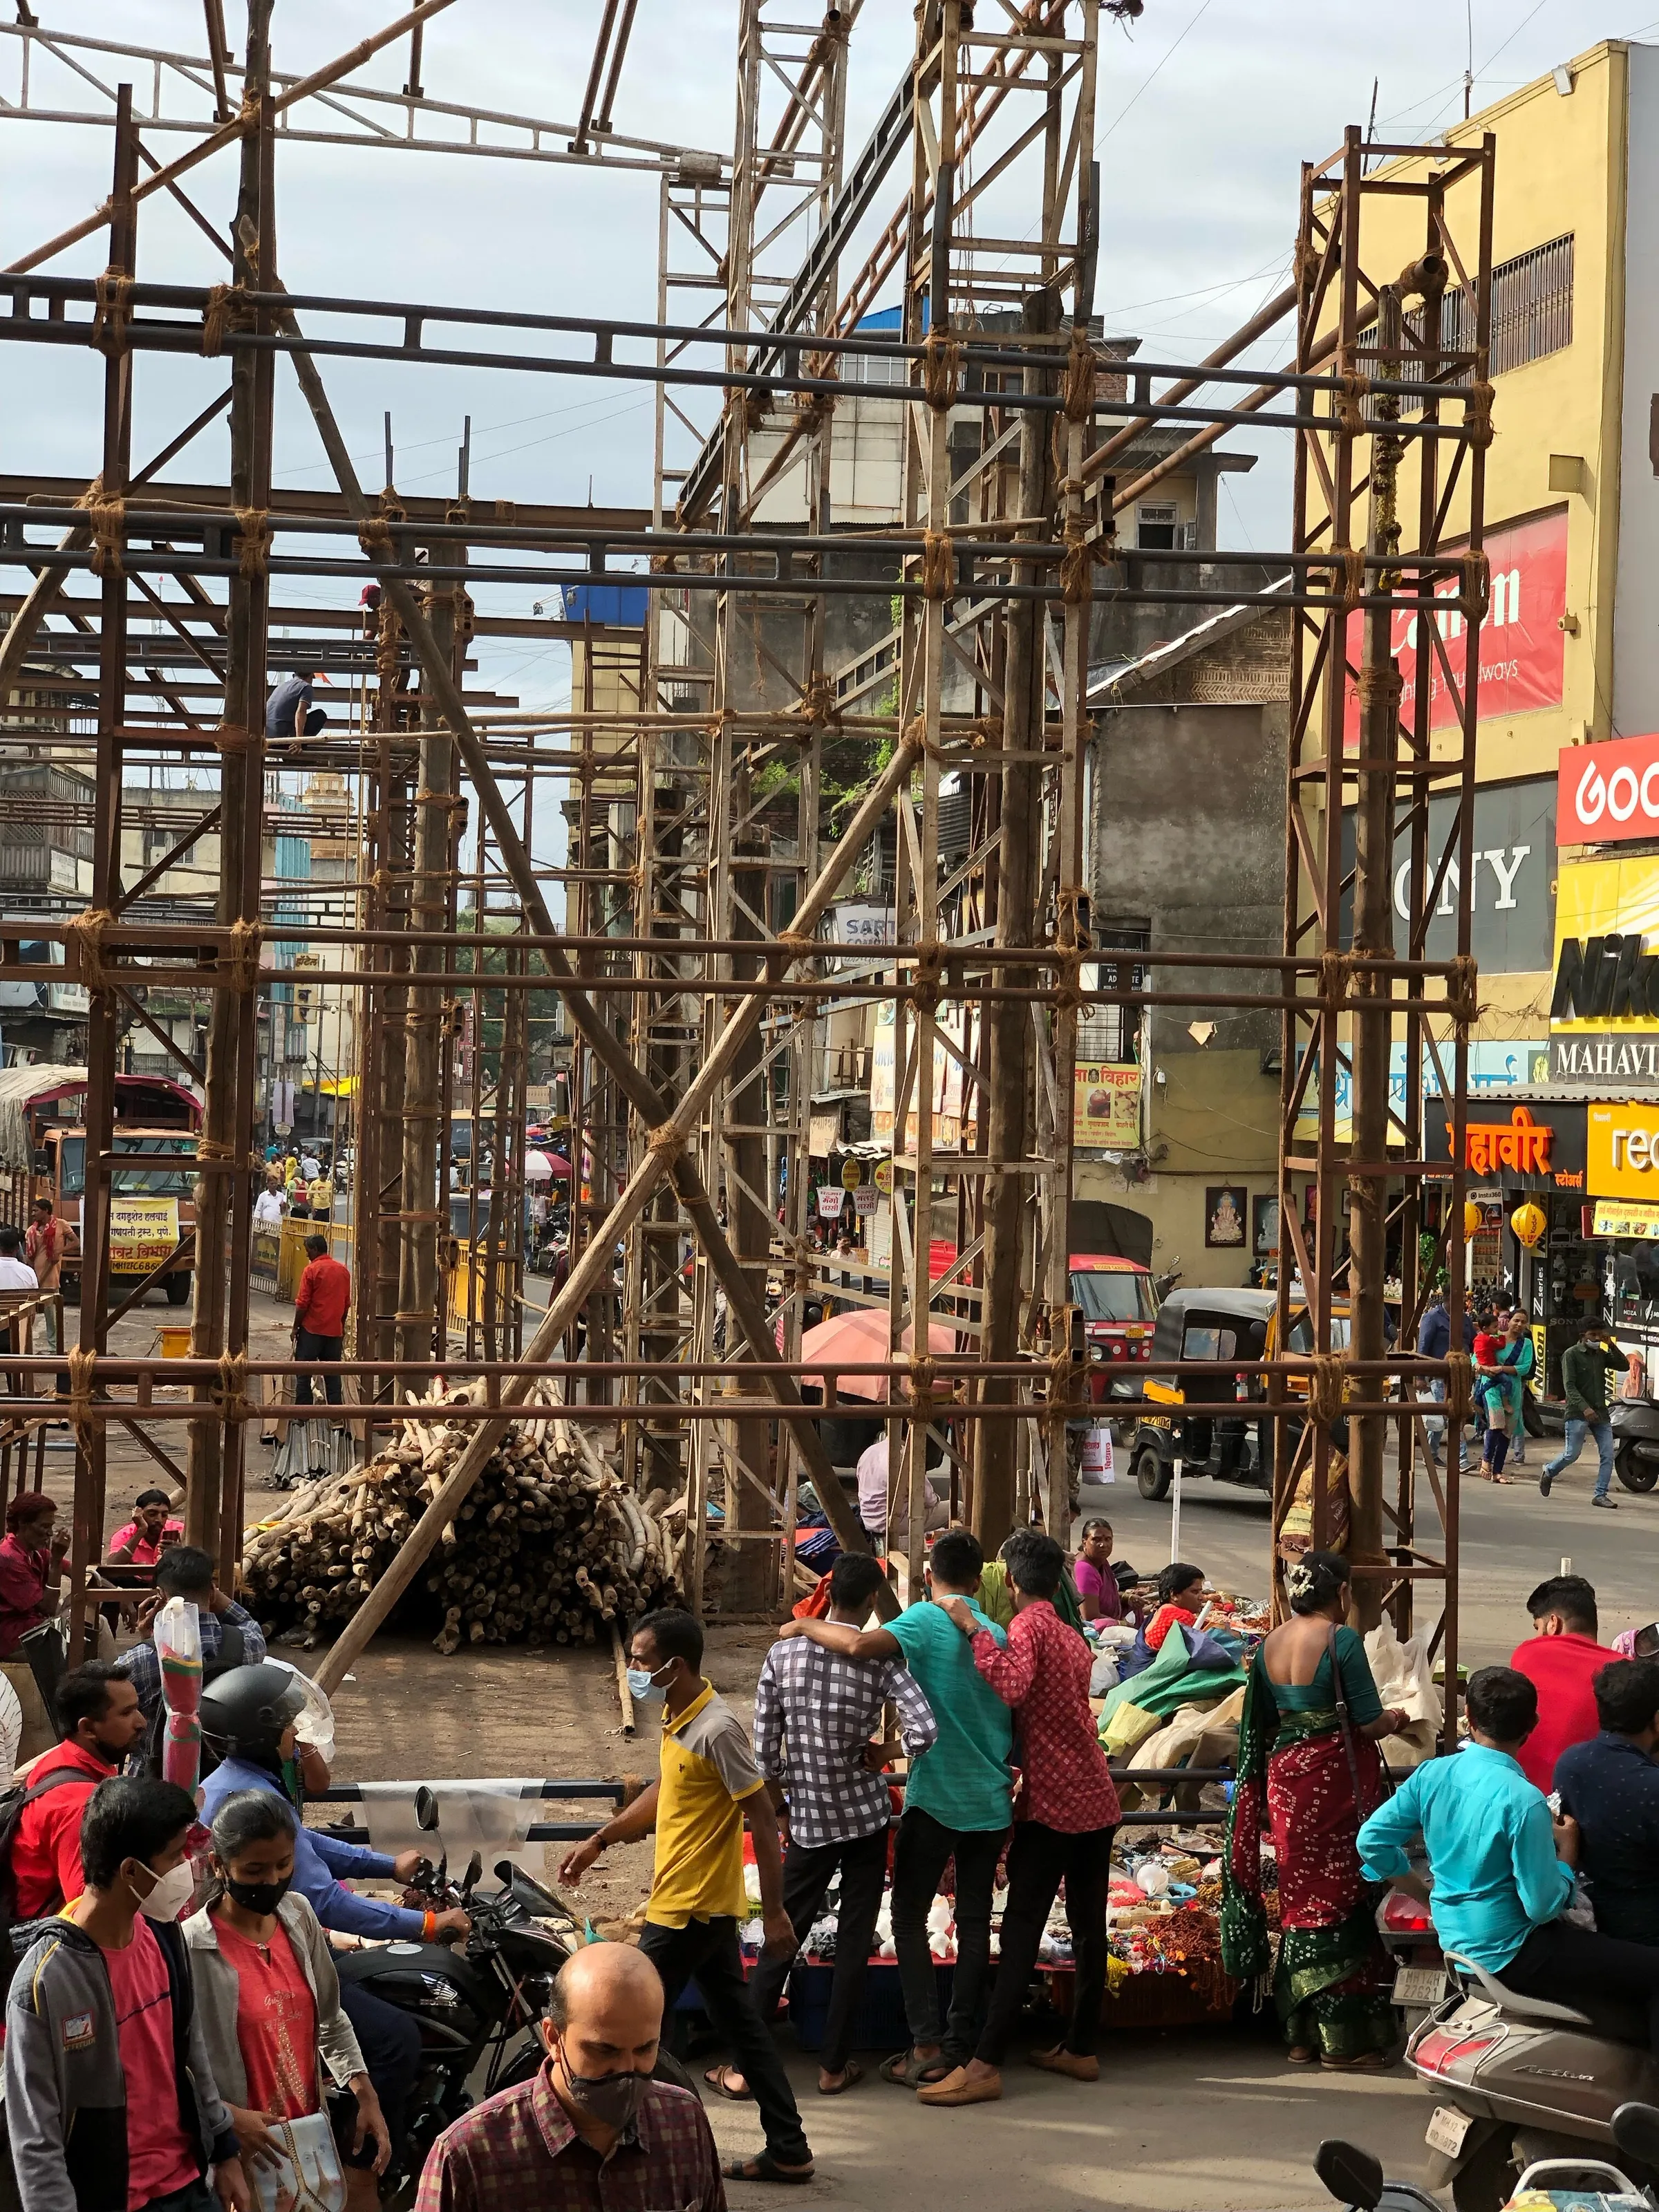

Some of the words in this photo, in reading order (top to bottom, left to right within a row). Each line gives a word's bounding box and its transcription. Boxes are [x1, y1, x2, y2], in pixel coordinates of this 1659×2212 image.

[1477, 659, 1519, 684] lways
[1394, 846, 1531, 921] ONY
[1100, 1065, 1138, 1088] विहार
[144, 1210, 168, 1222] हलवाई
[1534, 1331, 1544, 1391] Nikon
